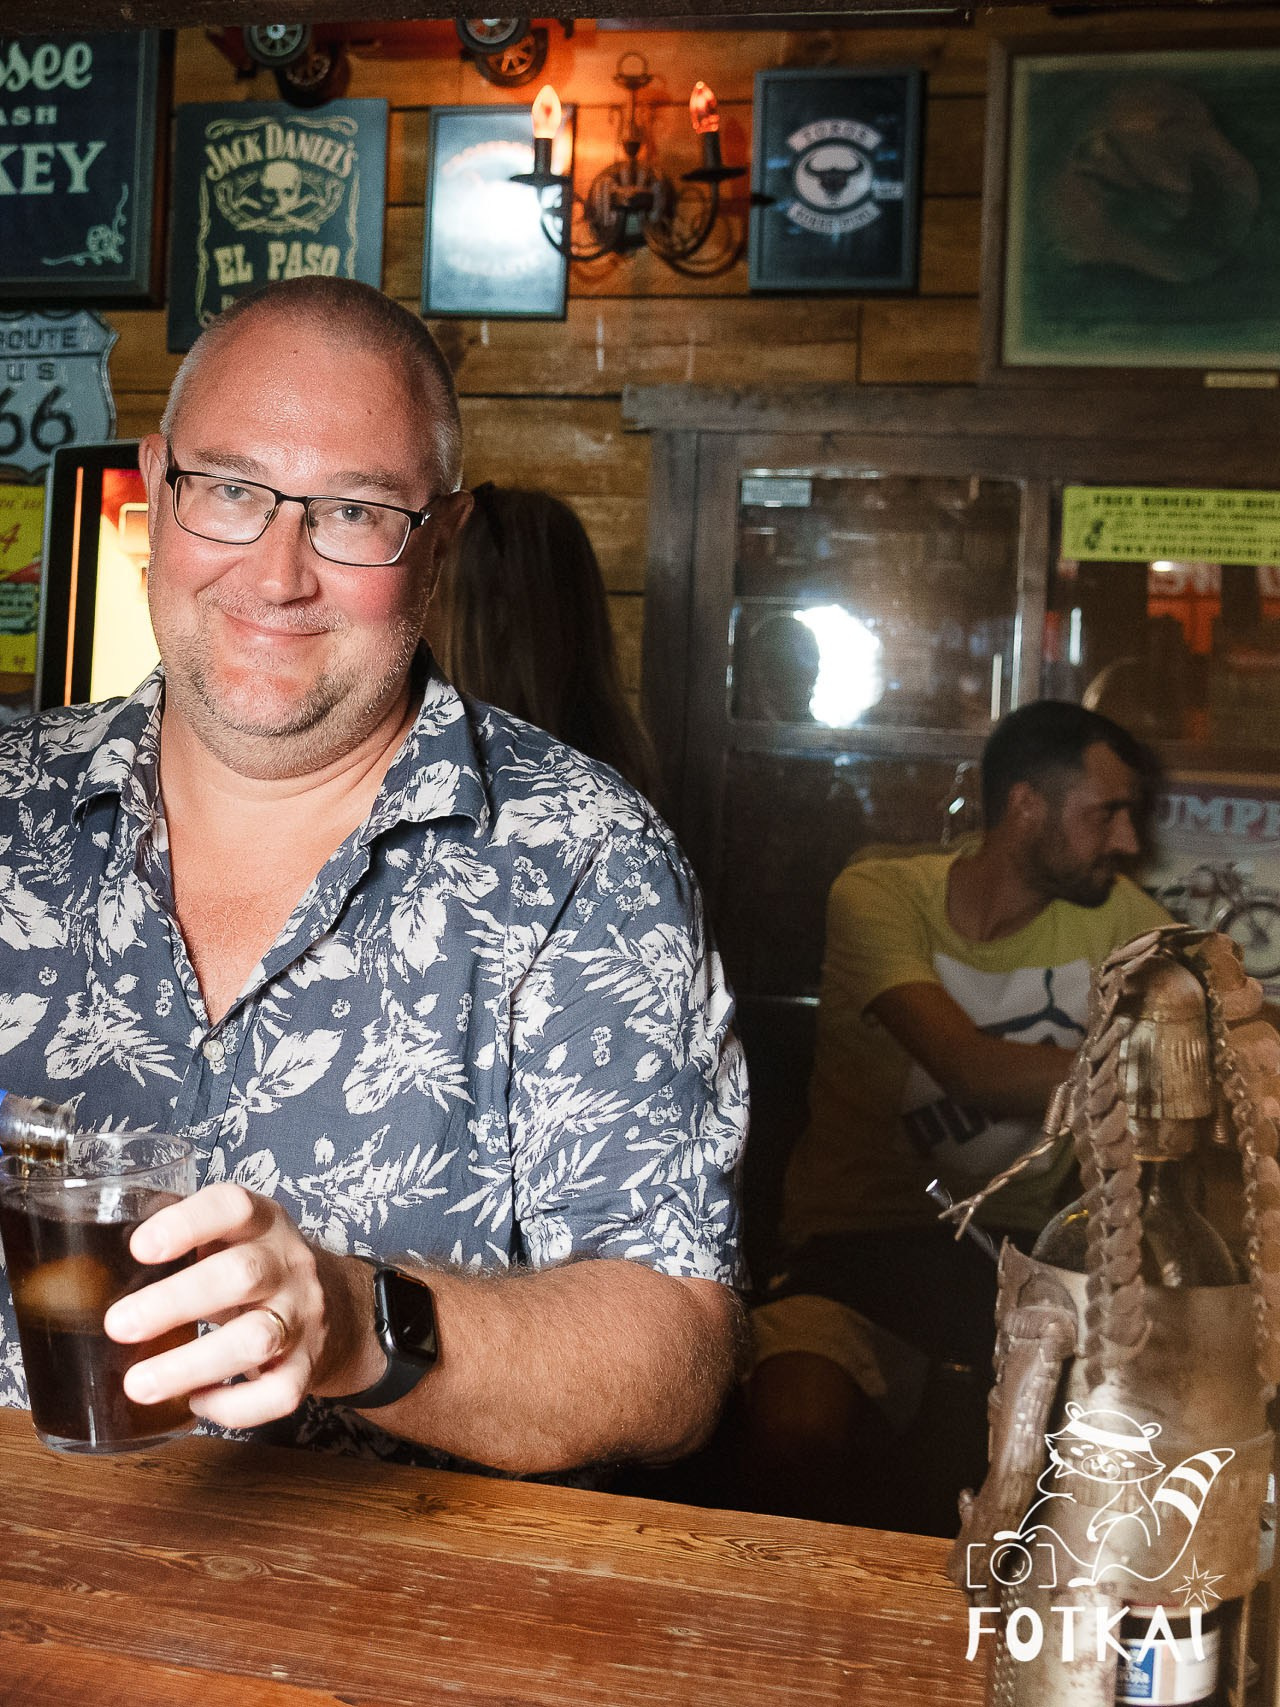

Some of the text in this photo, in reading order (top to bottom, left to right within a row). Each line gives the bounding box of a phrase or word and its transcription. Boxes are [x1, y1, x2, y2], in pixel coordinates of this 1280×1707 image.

[205, 132, 263, 181] JACK
[214, 241, 340, 287] EL PASO
